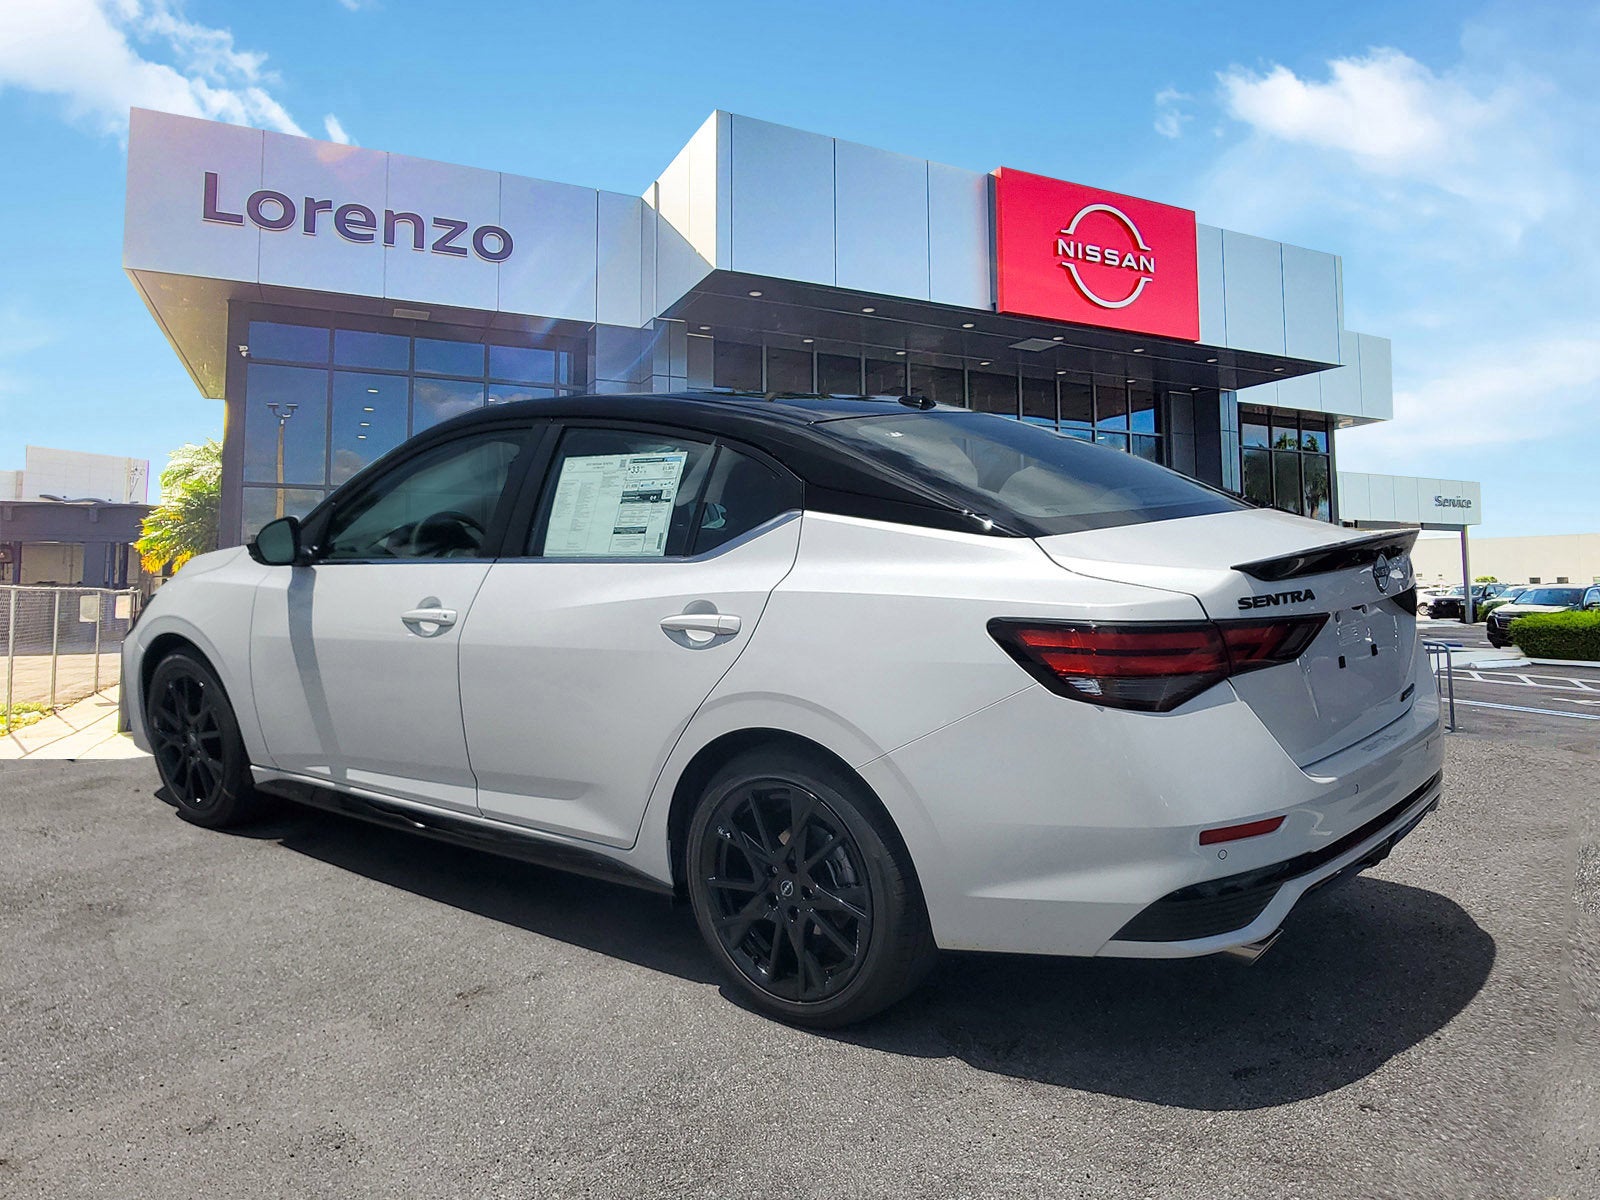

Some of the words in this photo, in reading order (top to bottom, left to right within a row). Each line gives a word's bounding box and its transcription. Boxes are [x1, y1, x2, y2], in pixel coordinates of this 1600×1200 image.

[202, 171, 514, 263] Lorenzo
[1057, 238, 1155, 273] NISSAN
[1434, 495, 1472, 509] Service
[1238, 588, 1316, 610] SENTRA
